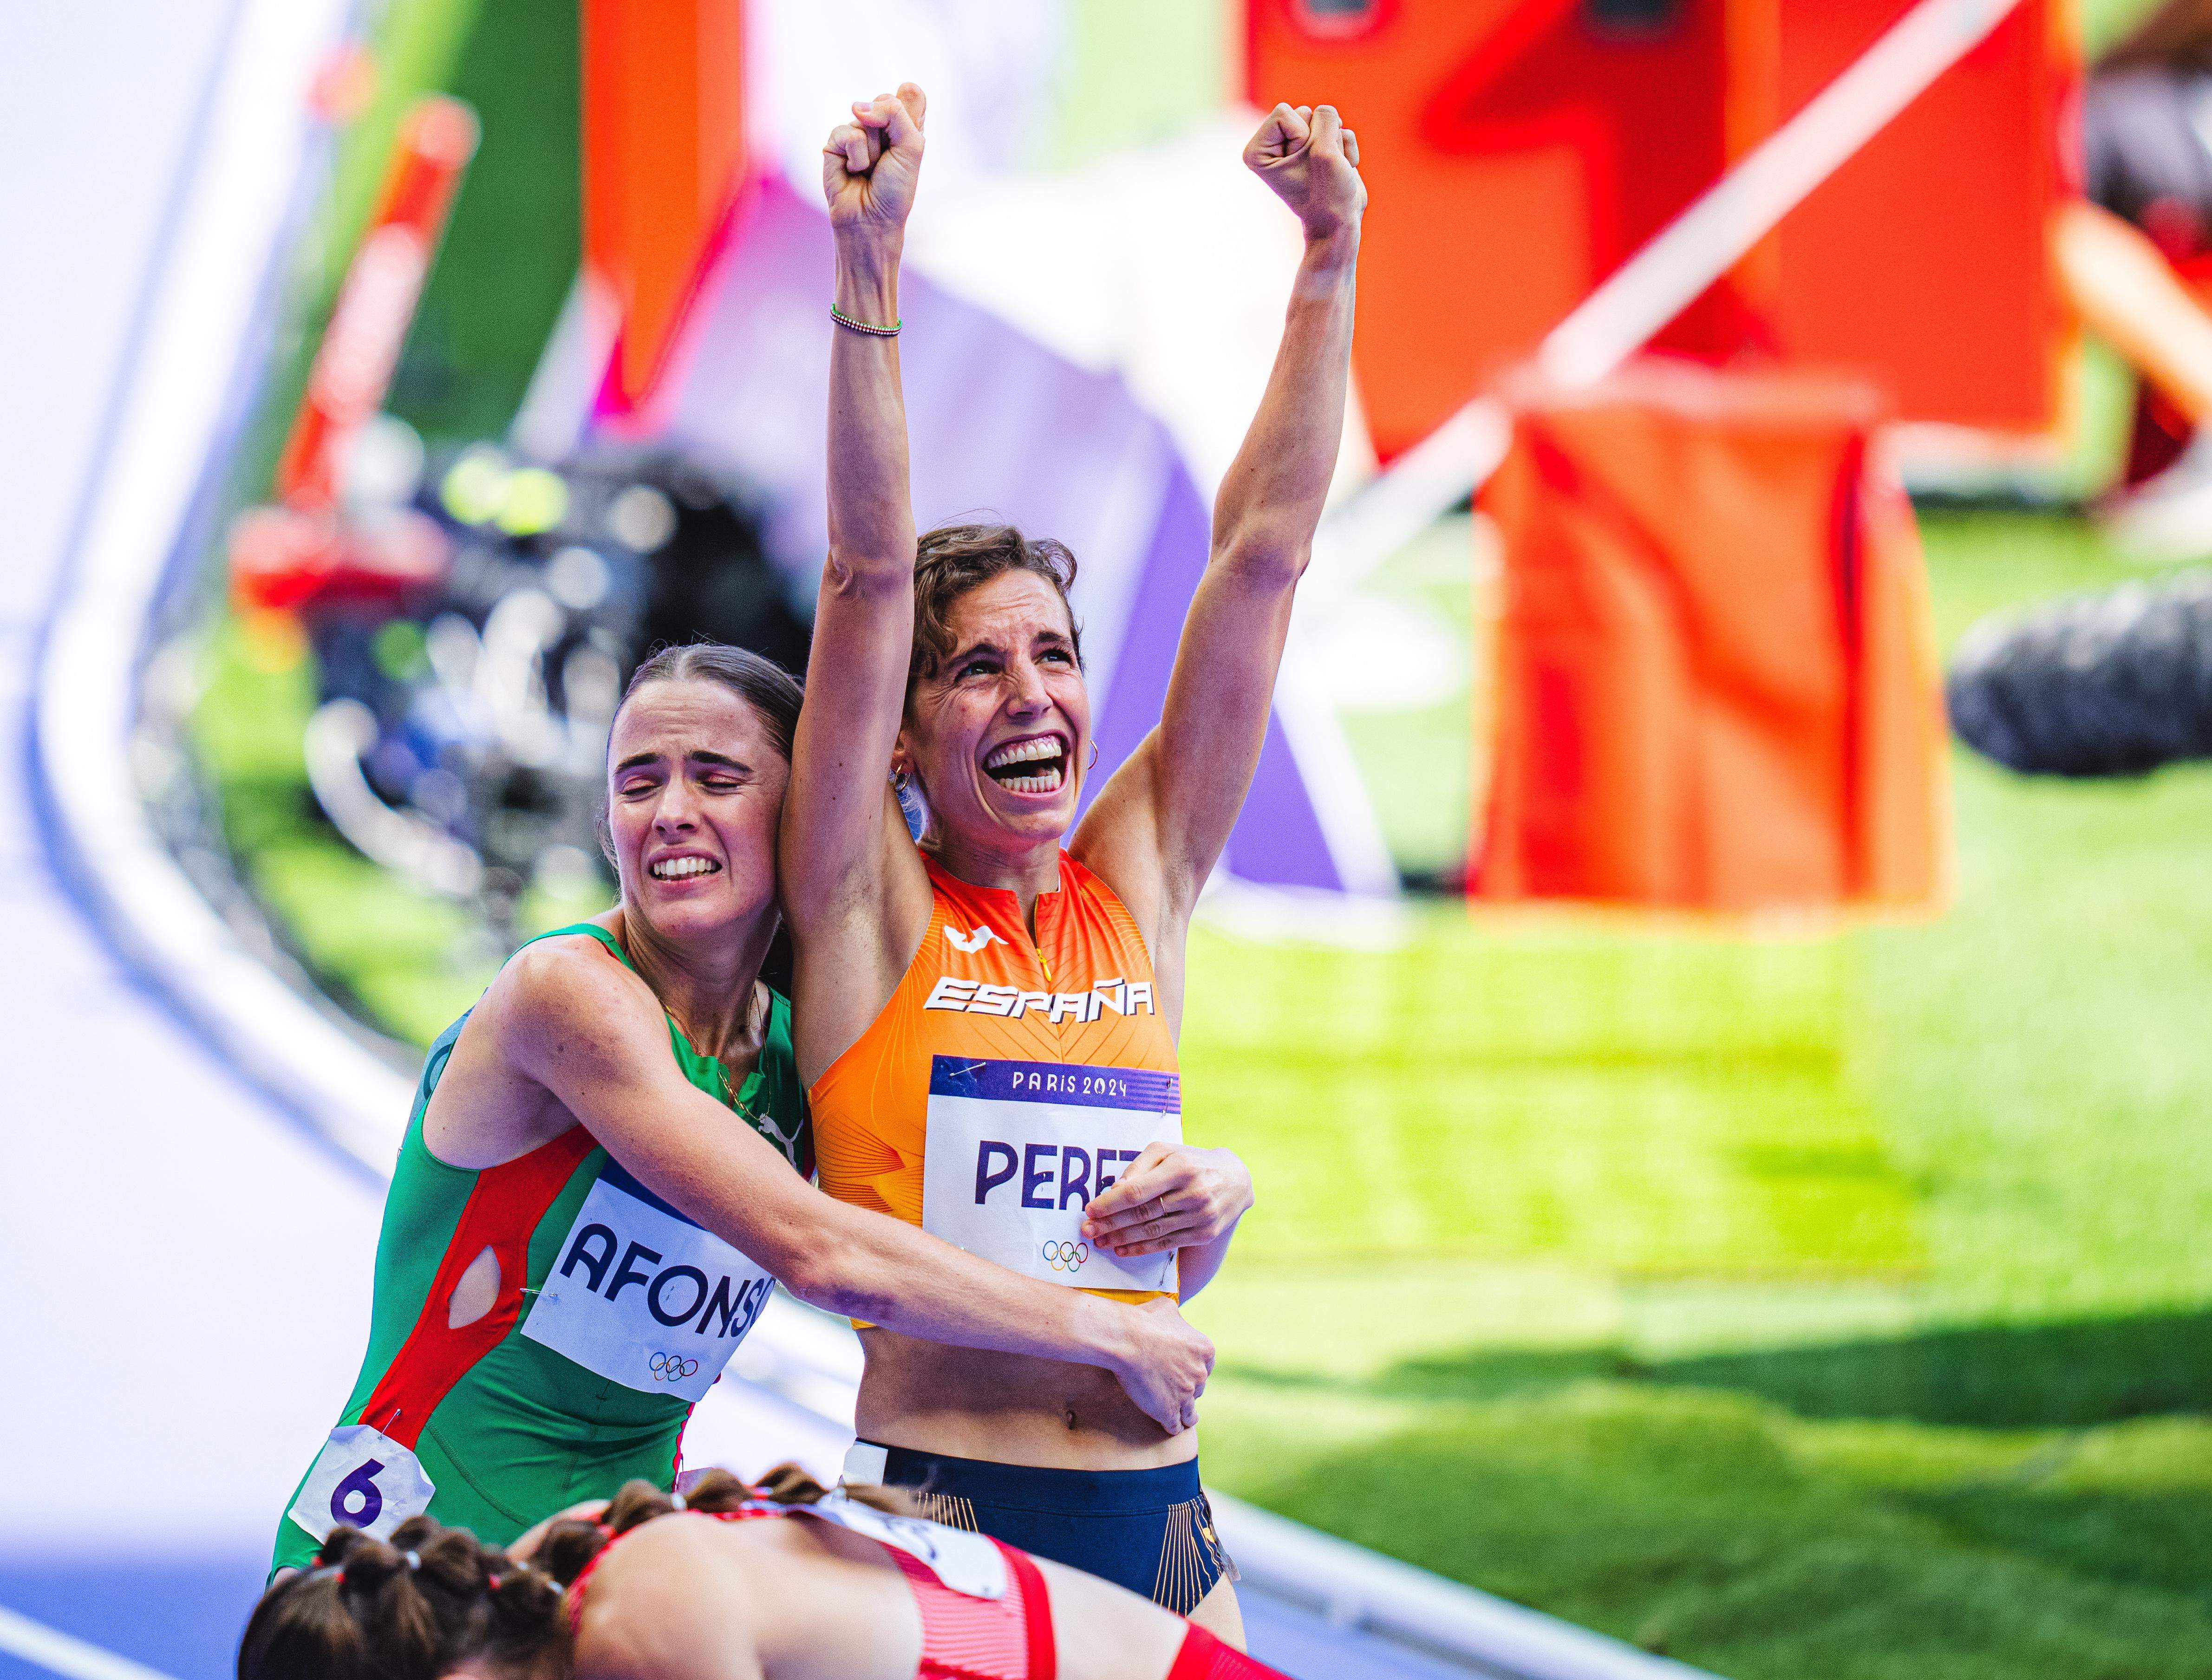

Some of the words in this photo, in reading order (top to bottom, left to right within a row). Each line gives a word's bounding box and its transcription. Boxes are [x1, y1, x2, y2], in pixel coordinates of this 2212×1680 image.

[923, 976, 1155, 1024] ESPAÑA
[1082, 1076, 1127, 1098] 2024
[974, 1140, 1142, 1212] PERE
[330, 1458, 385, 1529] 6
